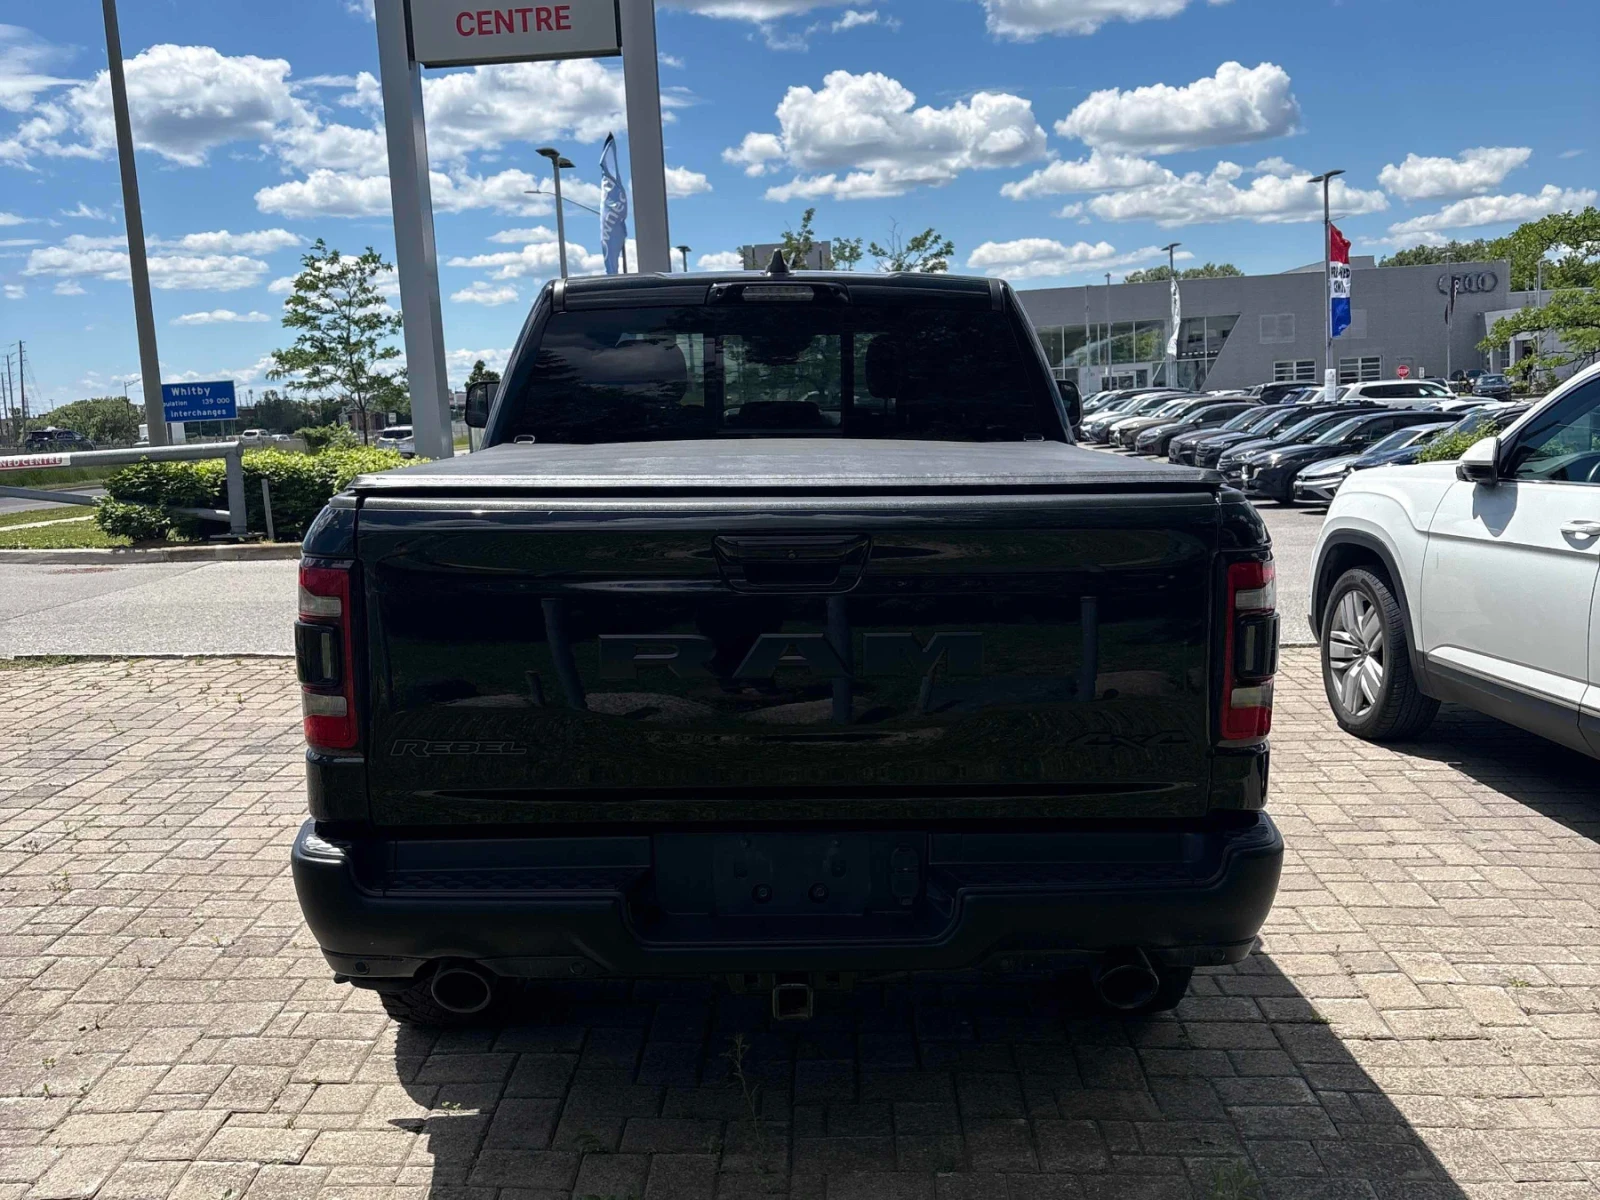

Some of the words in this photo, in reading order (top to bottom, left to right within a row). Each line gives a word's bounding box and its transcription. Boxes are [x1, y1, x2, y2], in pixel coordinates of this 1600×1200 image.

[456, 5, 571, 37] CENTRE
[171, 387, 210, 397] Whitby
[171, 409, 227, 417] Interchanges
[22, 457, 61, 466] CENTRE
[598, 633, 983, 680] RAM
[389, 738, 527, 757] REBEL
